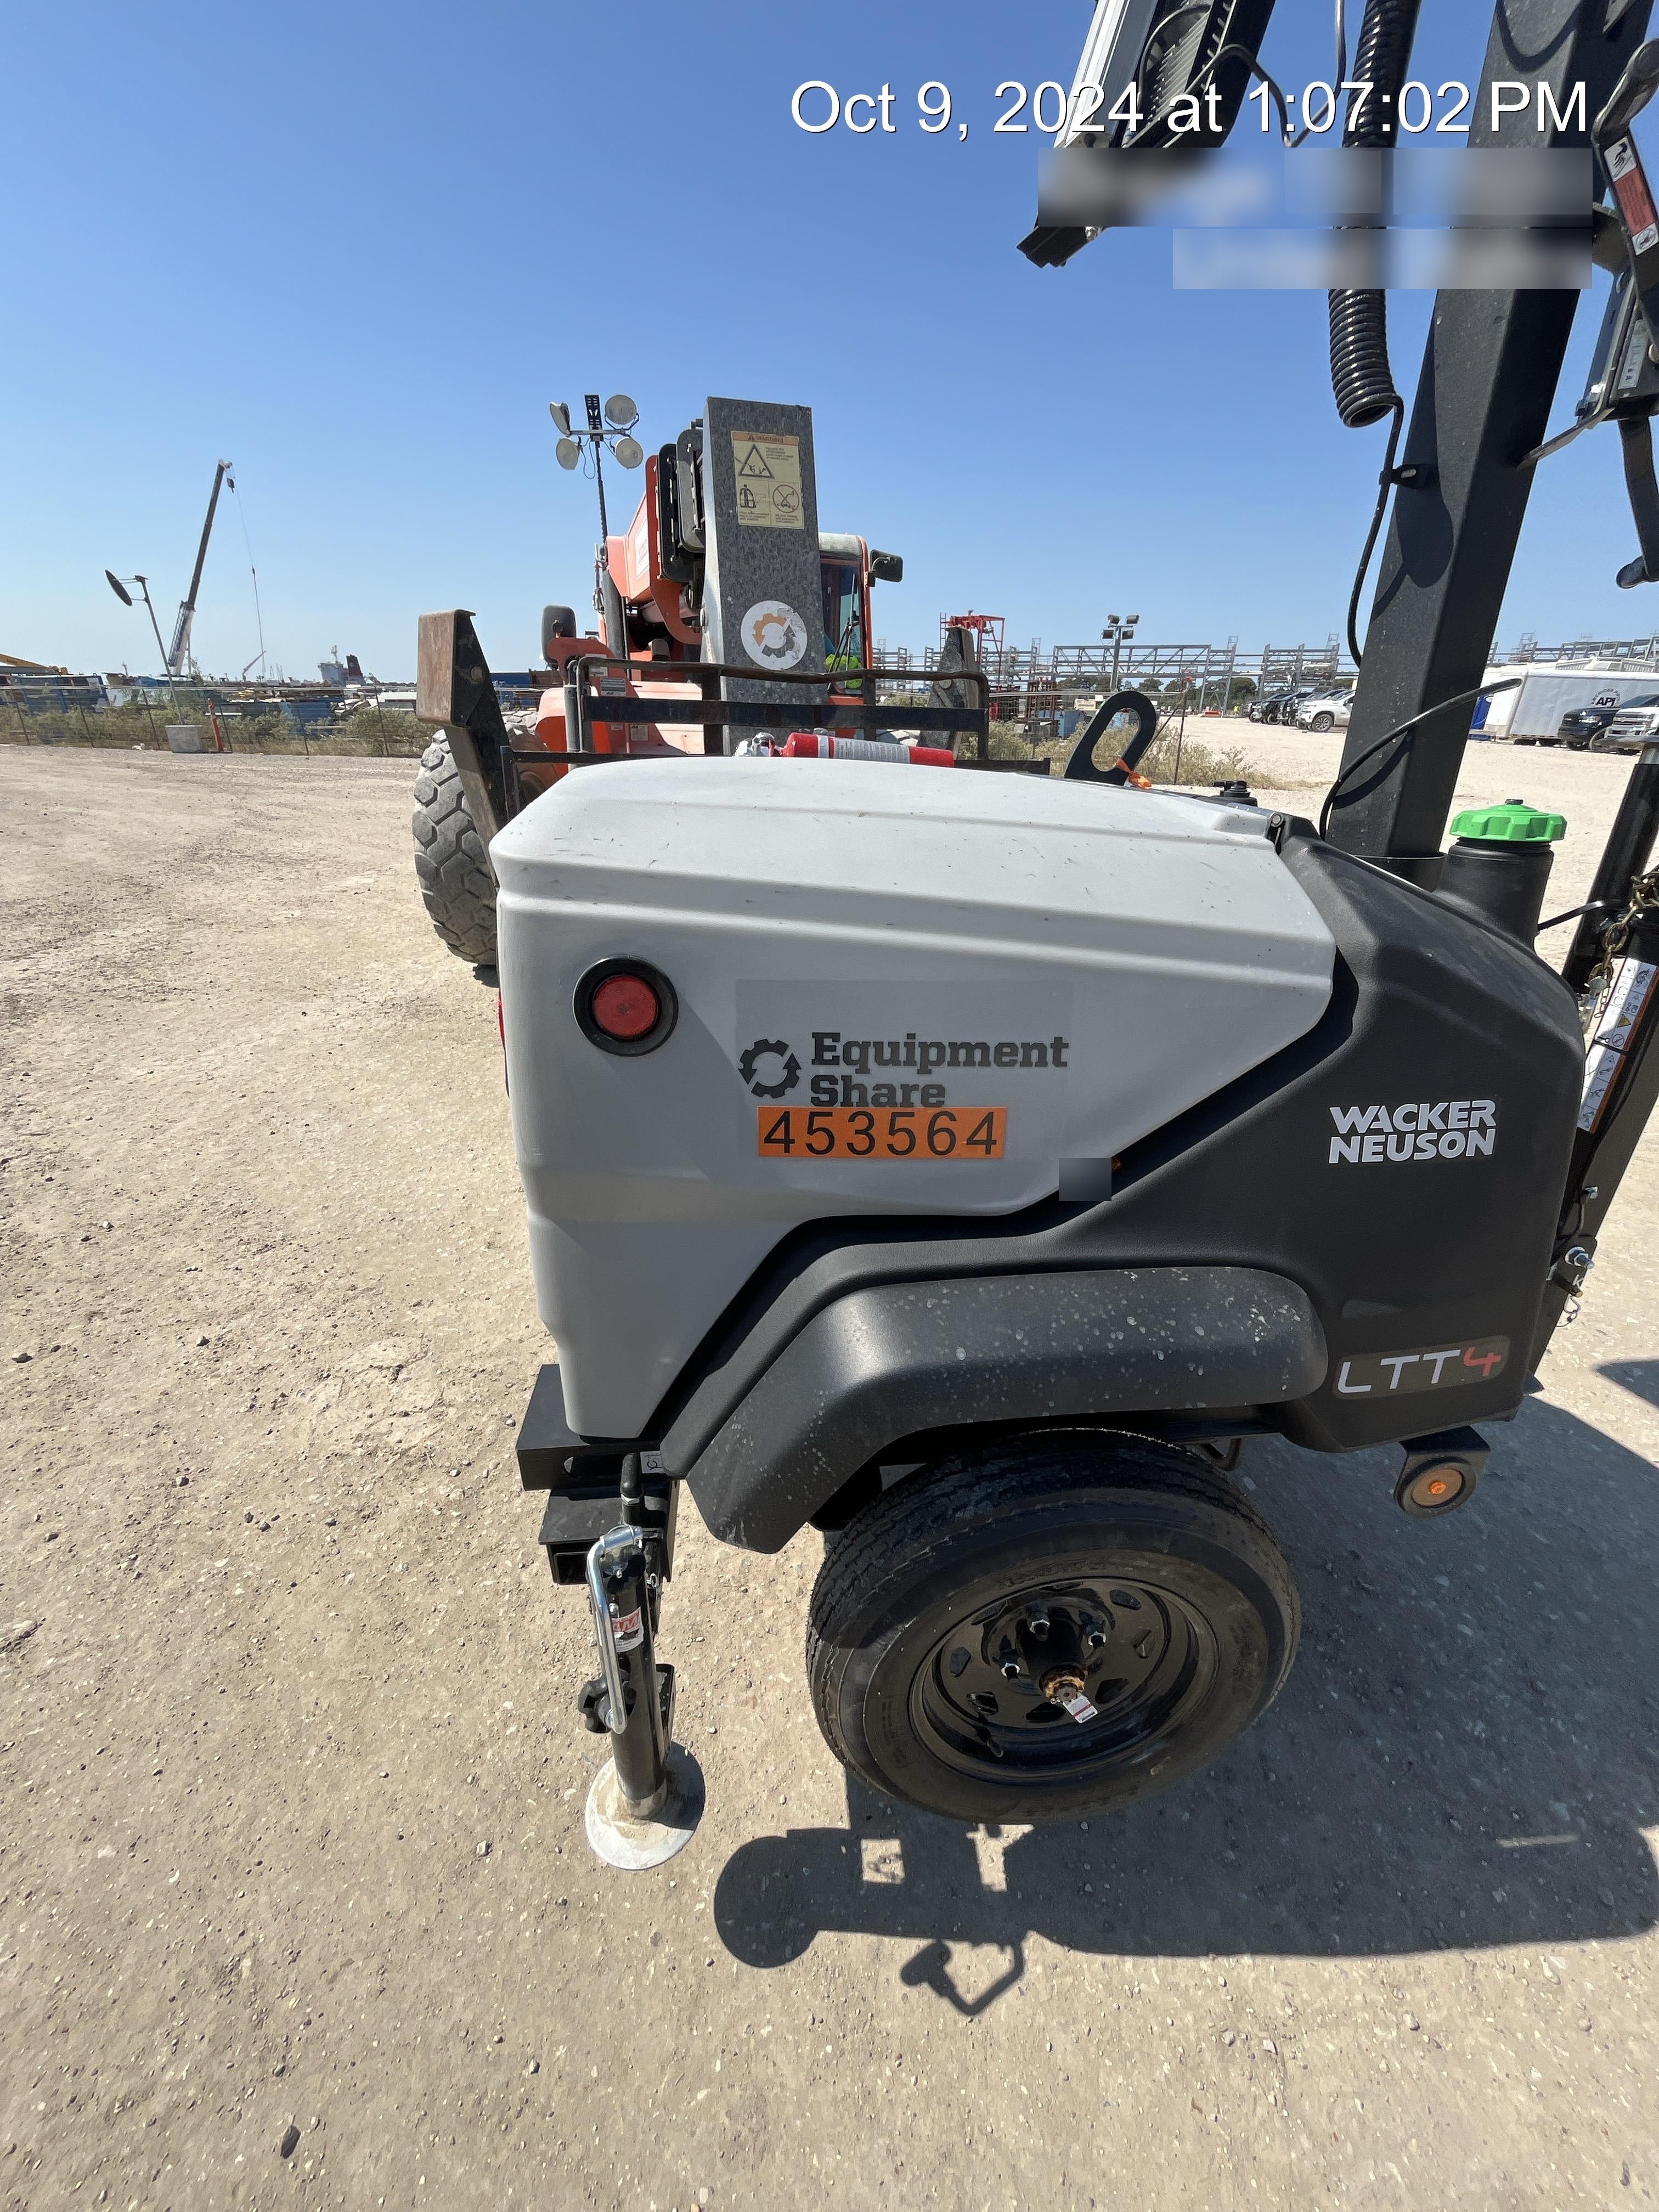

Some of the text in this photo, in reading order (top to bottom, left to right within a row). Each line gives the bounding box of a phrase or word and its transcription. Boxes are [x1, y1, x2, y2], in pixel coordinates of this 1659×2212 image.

[755, 435, 784, 443] WARNING
[1595, 697, 1616, 707] API
[811, 1032, 1069, 1075] Equipment
[810, 1074, 946, 1108] Share
[763, 1110, 997, 1156] 453564
[1329, 1099, 1497, 1134] WACKER
[1328, 1128, 1497, 1164] NEUSON
[612, 1615, 639, 1633] AM
